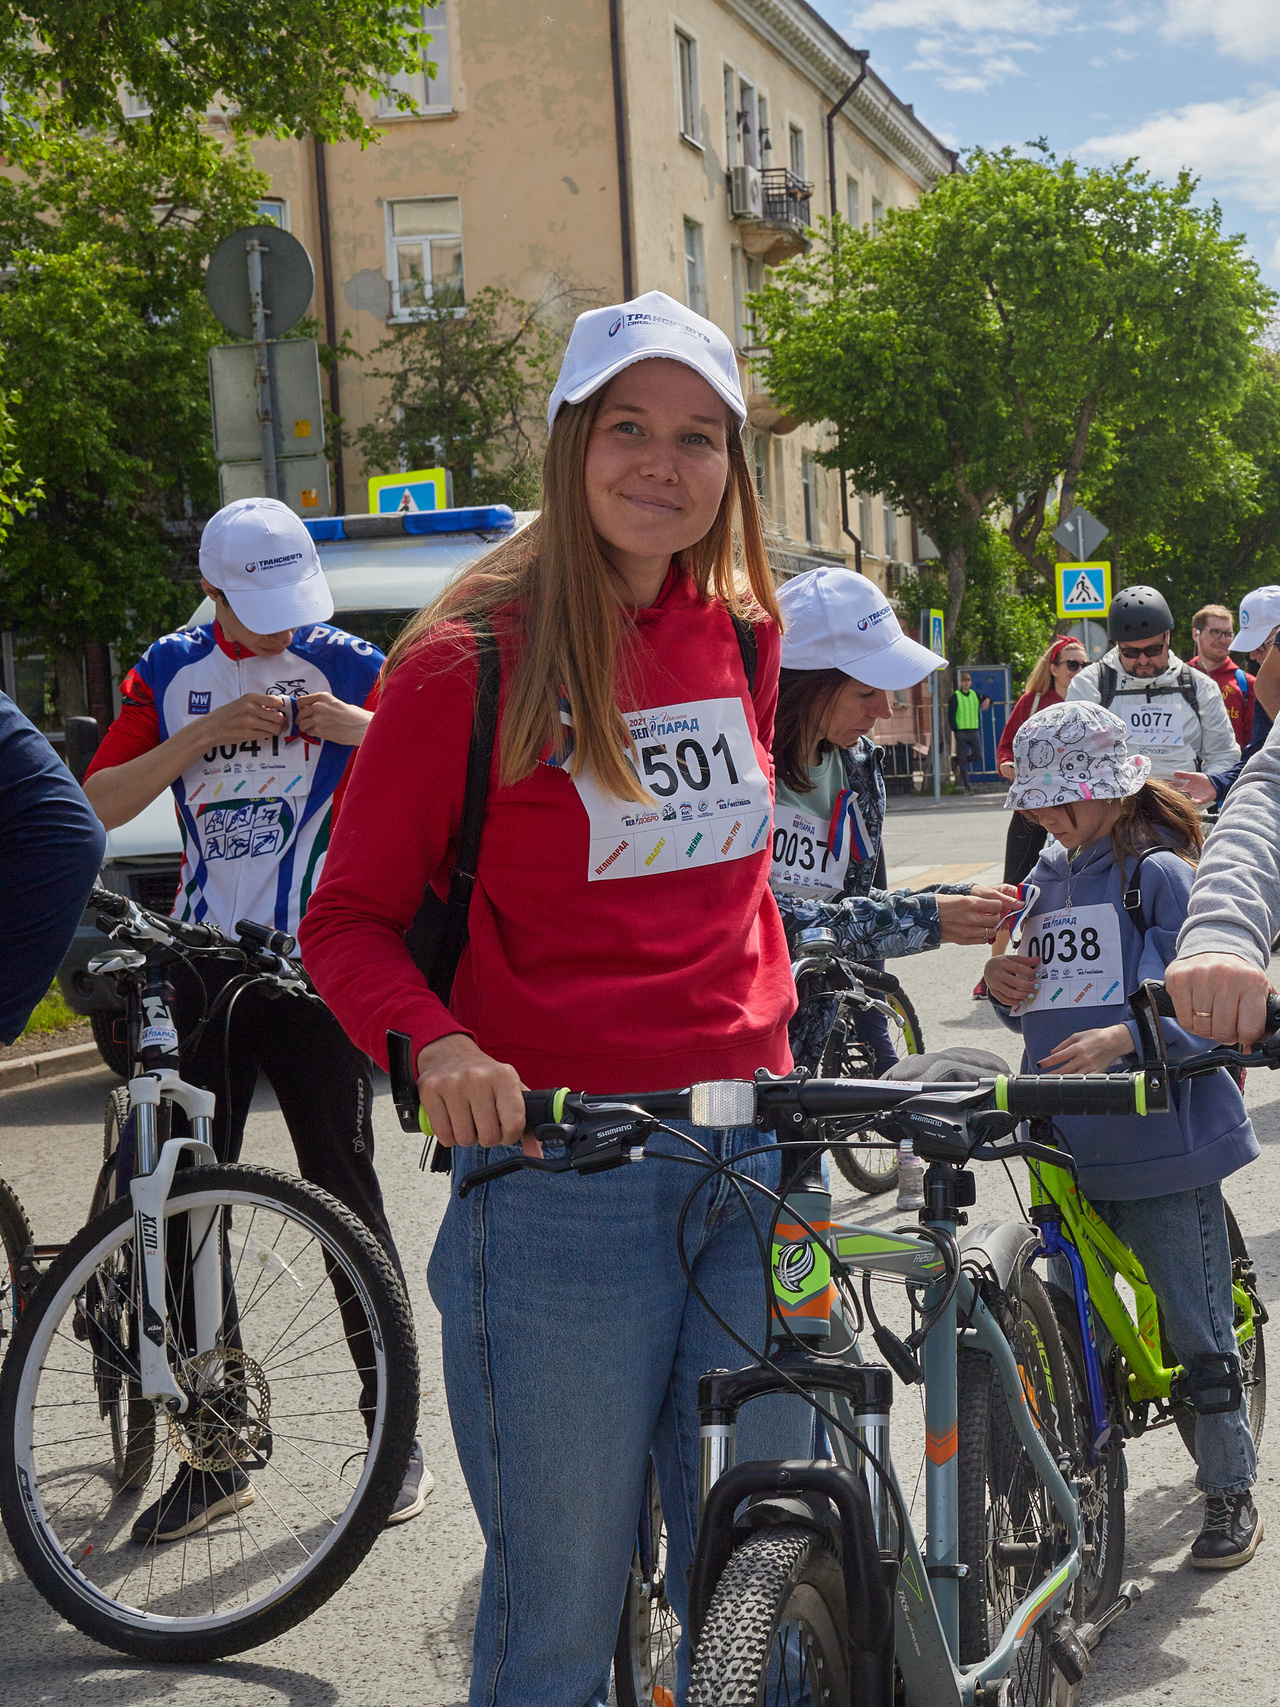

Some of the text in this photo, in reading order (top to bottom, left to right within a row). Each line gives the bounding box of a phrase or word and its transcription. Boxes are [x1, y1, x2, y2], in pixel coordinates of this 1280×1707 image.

[258, 552, 302, 567] ТРАНСНЕФТЬ
[306, 625, 374, 656] PRO
[191, 693, 208, 705] NW
[1131, 712, 1173, 727] 0077
[622, 733, 740, 803] 501
[643, 836, 667, 867] КВАДРАТ
[685, 831, 704, 858] ЗМЕЙКА
[720, 820, 742, 855] ПАМП-ТРЕК
[772, 828, 831, 874] 0037
[594, 839, 629, 875] ВЕЛОПАРАД
[1028, 927, 1101, 965] 0038
[596, 1124, 632, 1139] SHIMANO
[910, 1113, 943, 1127] SHIMANO
[142, 1212, 158, 1249] XCM
[1097, 1504, 1109, 1579] FORMAT
[897, 1589, 910, 1613] TKS
